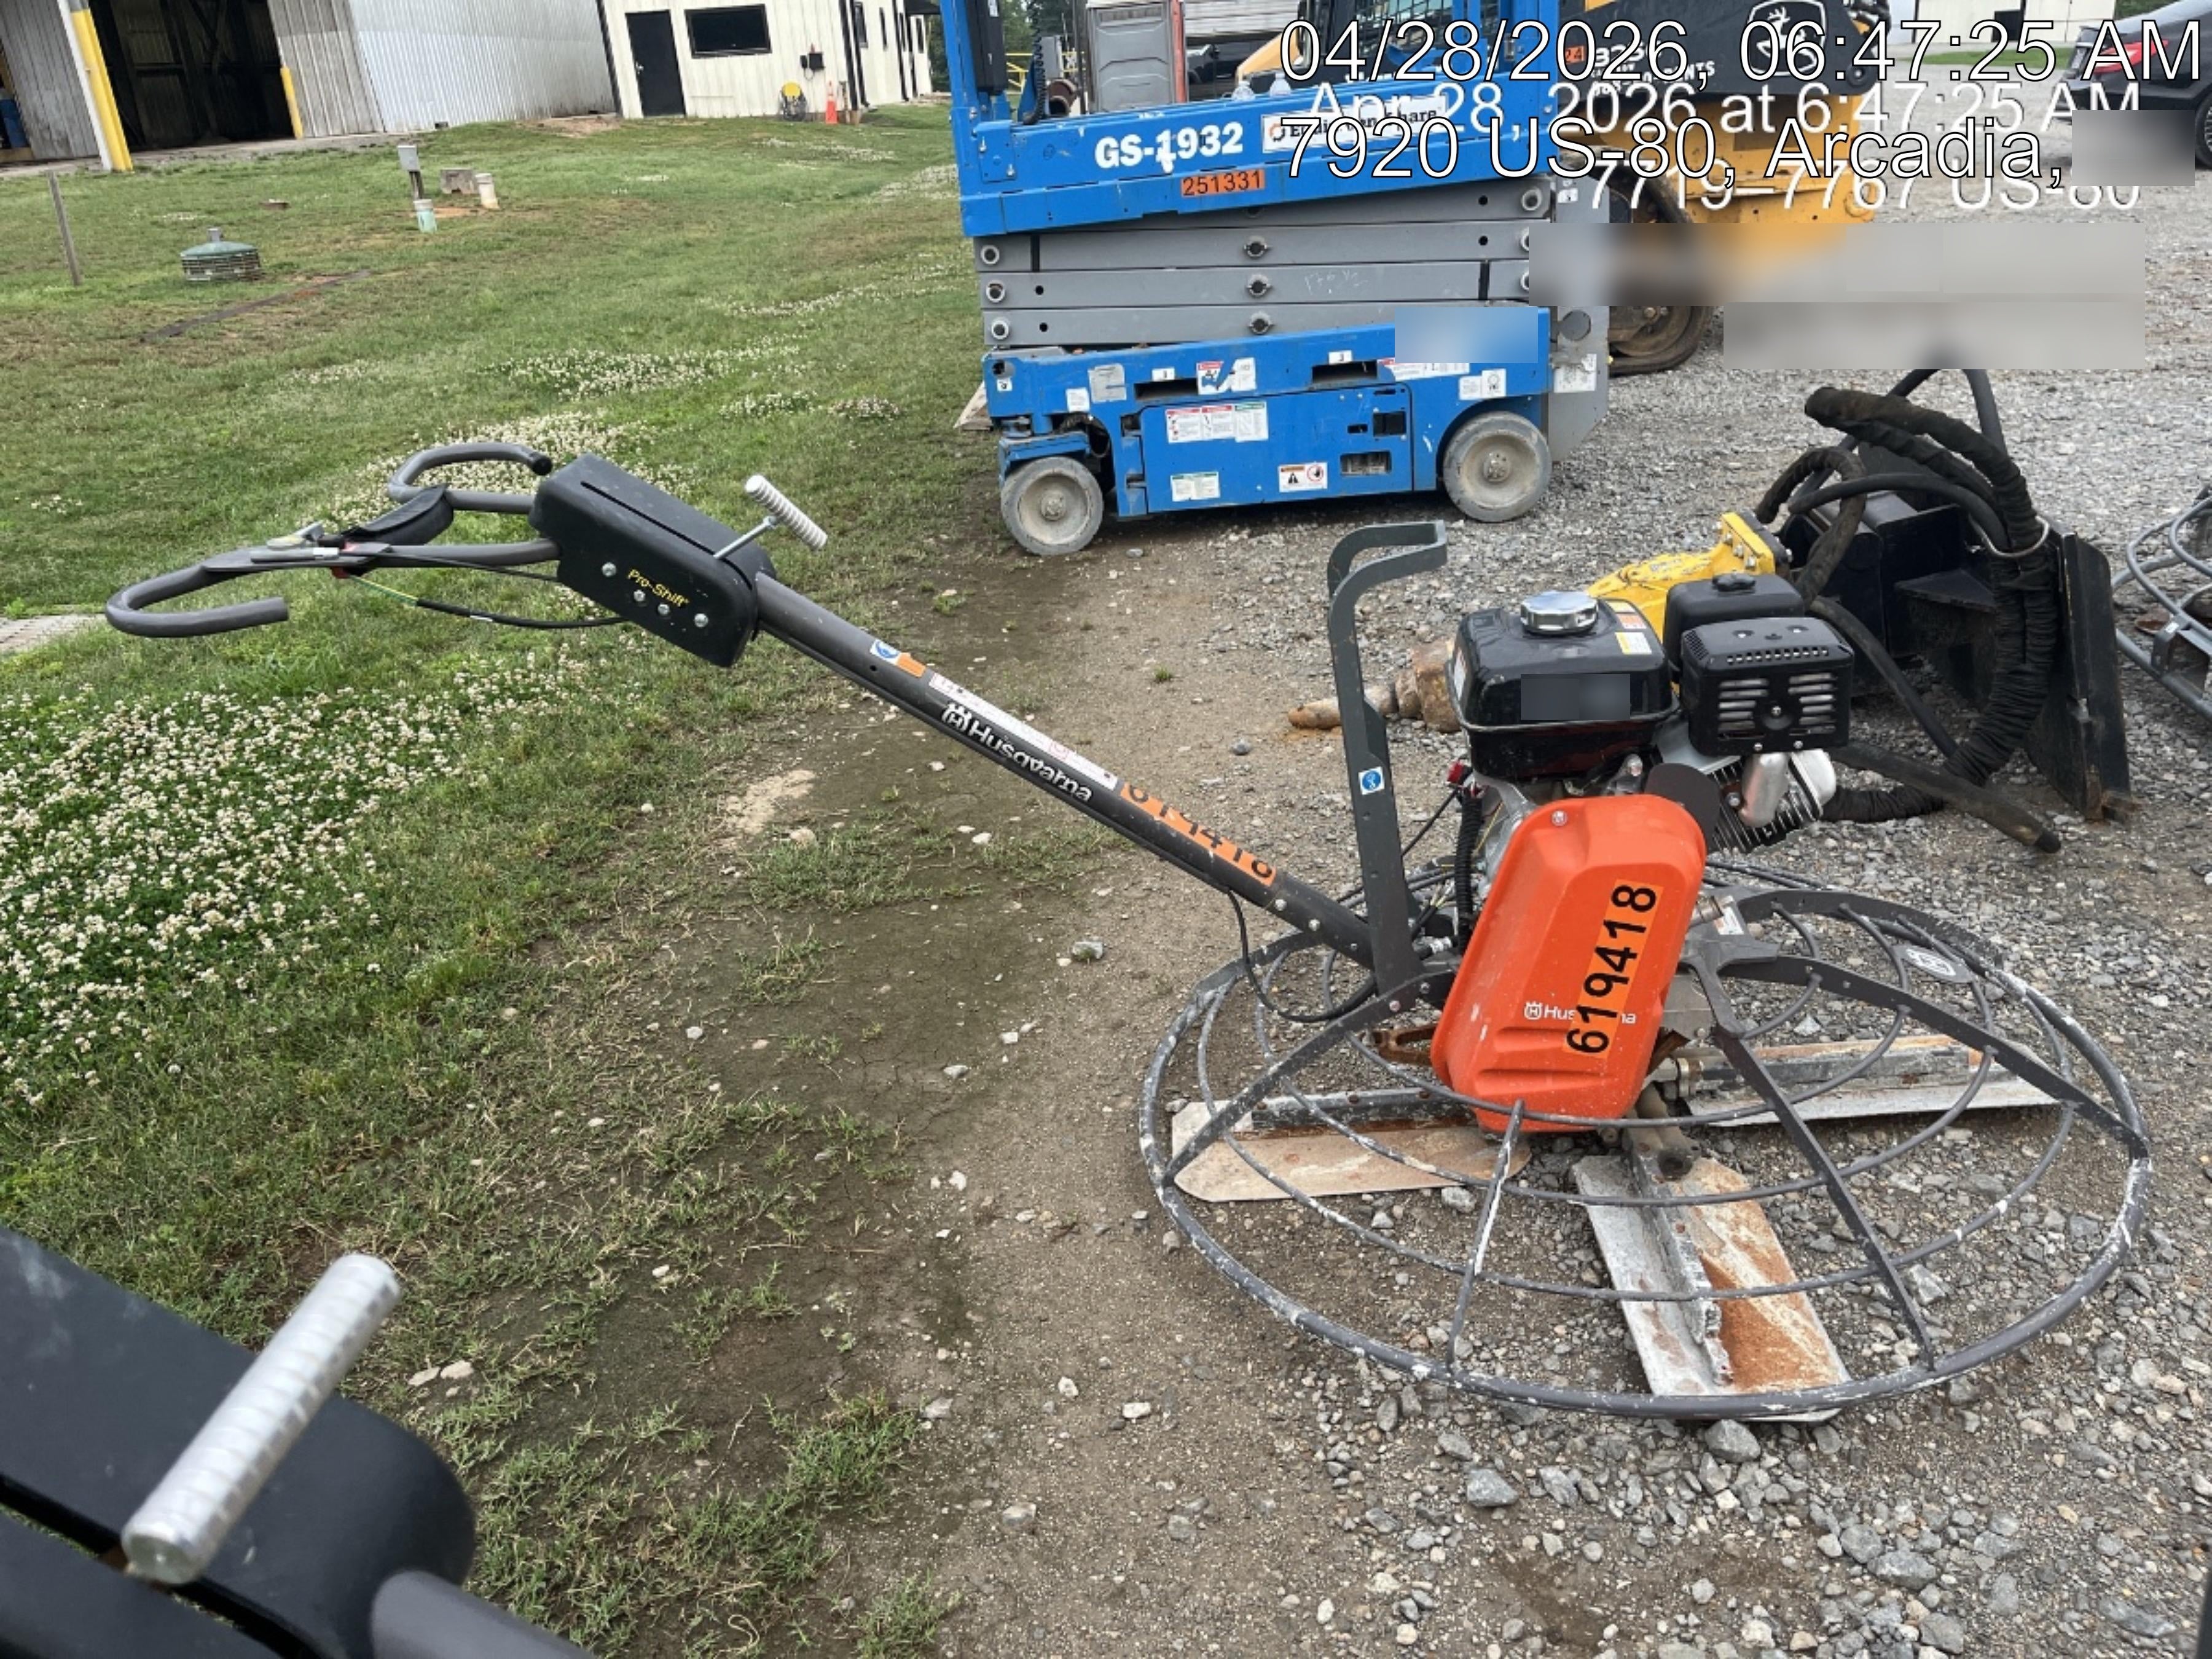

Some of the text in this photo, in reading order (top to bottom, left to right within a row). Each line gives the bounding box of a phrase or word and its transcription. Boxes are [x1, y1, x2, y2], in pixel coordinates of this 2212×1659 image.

[1094, 121, 1243, 168] GS-1932
[1183, 170, 1262, 196] 251331
[967, 719, 1094, 802] Husqvarna
[1566, 885, 1657, 1054] 619418
[1544, 1005, 1636, 1024] Husna
